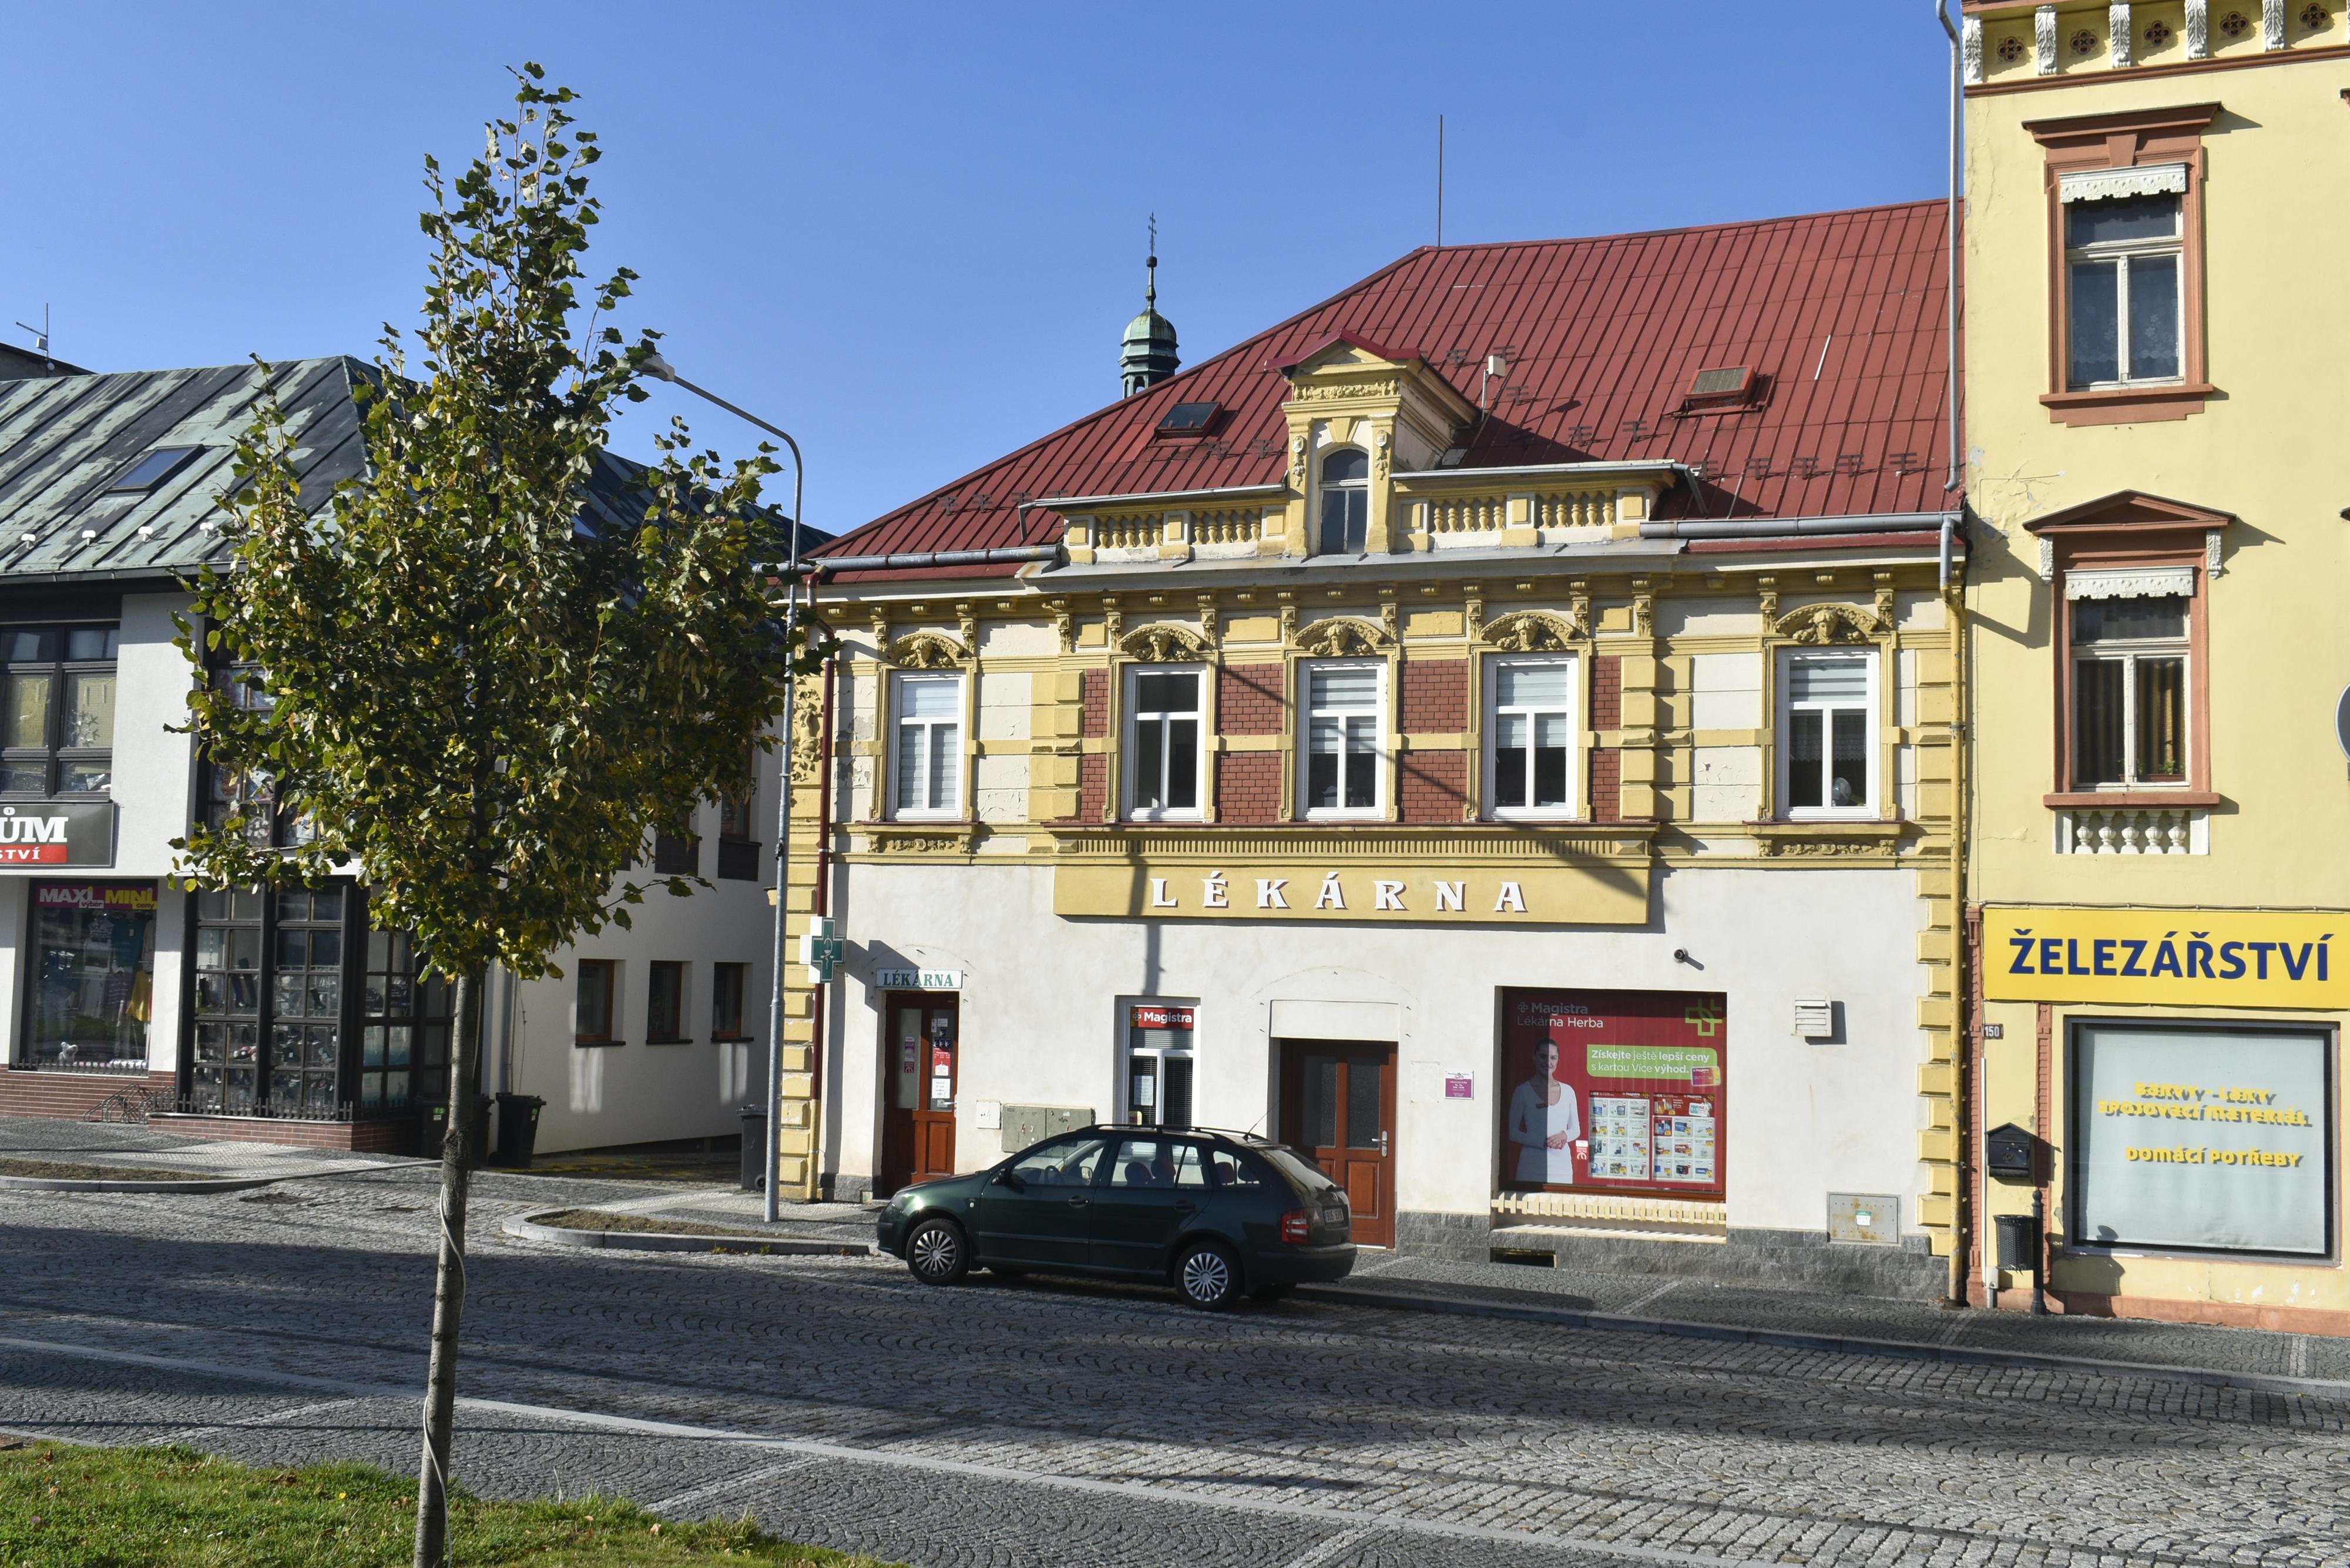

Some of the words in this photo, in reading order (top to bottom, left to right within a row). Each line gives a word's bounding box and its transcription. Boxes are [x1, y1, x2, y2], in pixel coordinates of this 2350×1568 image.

[1150, 871, 1528, 912] LÉKÁRNA
[2009, 928, 2335, 981] ŽELEZÁŘSTVÍ
[884, 969, 954, 987] LÉKÁRNA
[1532, 1002, 1588, 1016] Magistra
[1144, 1012, 1192, 1023] Magistra
[1518, 1015, 1563, 1027] Lékárna
[1568, 1017, 1603, 1028] Herba
[1985, 1026, 2000, 1037] 150
[1592, 1050, 1631, 1060] Získejte
[1633, 1051, 1657, 1061] ještě
[1659, 1052, 1683, 1062] lepší
[1685, 1054, 1710, 1063] ceny
[1599, 1062, 1629, 1072] kartou
[1631, 1063, 1652, 1073] Více
[1654, 1064, 1689, 1075] výhod.
